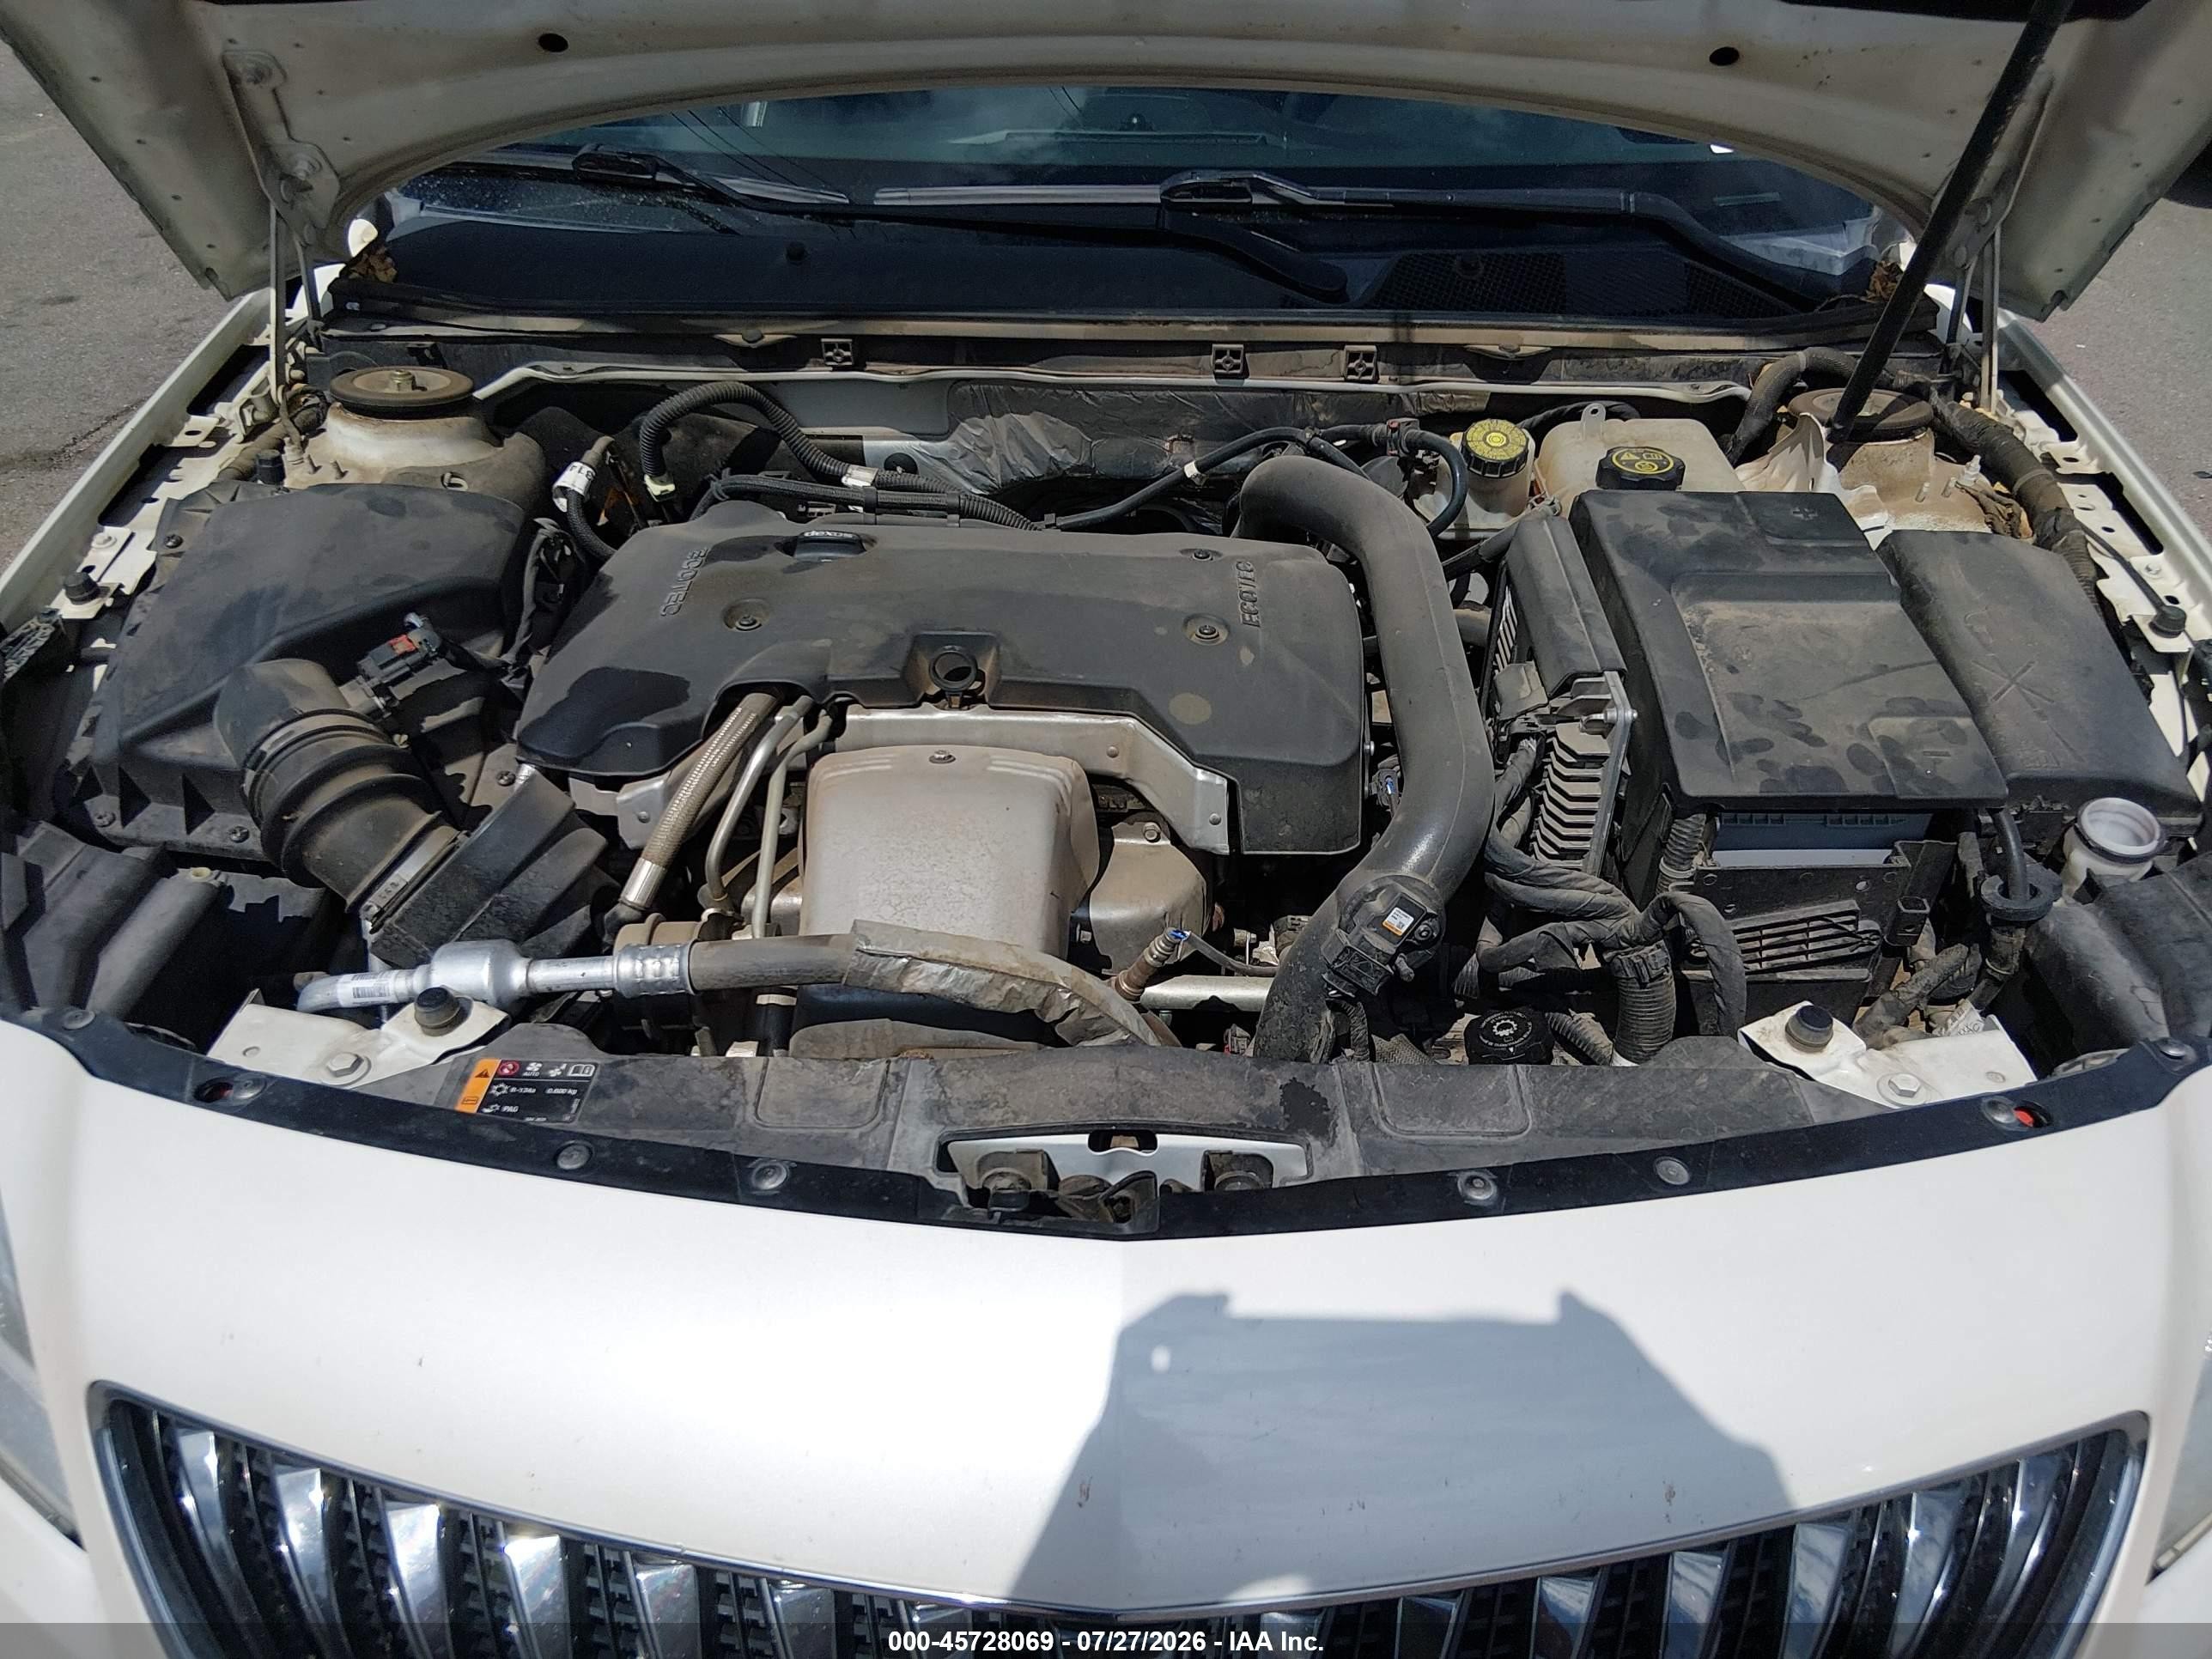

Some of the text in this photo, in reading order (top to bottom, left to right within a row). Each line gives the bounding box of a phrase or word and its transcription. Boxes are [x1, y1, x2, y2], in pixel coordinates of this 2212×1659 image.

[660, 548, 709, 617] ECOTEC
[1235, 561, 1261, 628] ECOTEC
[501, 1104, 520, 1113] PAG
